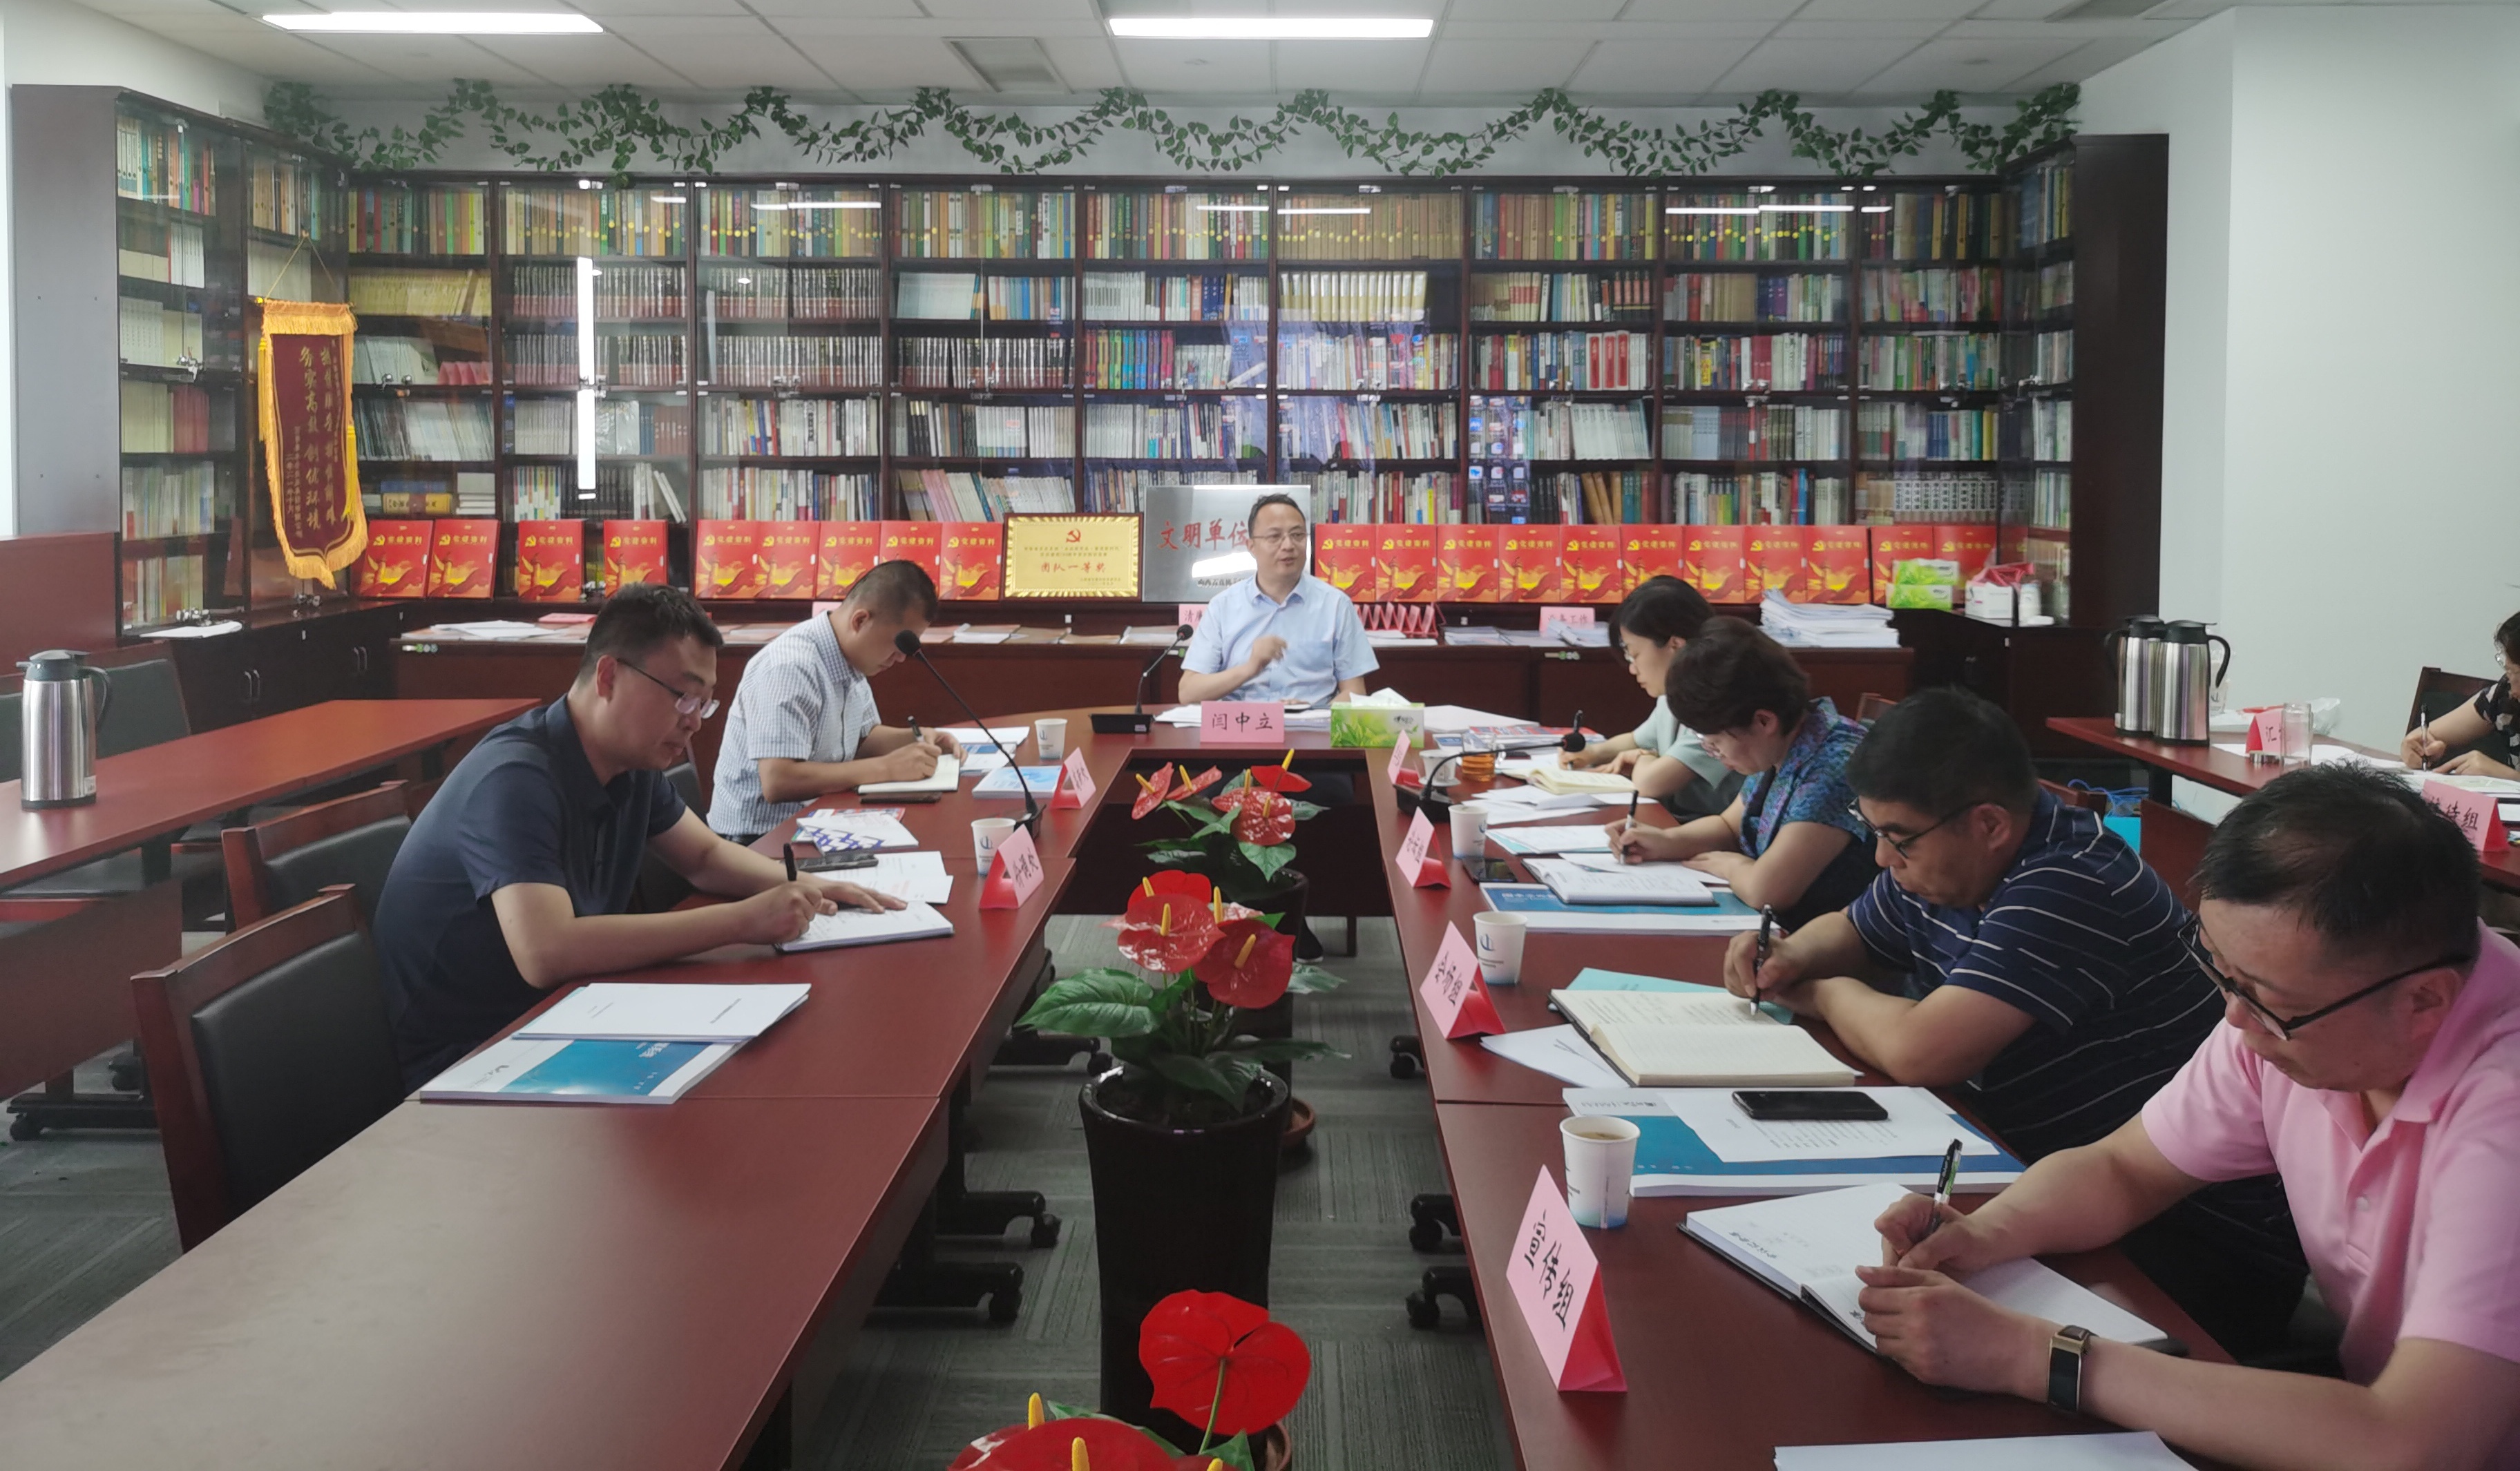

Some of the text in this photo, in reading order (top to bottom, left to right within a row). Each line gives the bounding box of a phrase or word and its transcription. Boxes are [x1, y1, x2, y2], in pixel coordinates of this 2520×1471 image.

[1157, 518, 1249, 550] 文明单位
[1212, 711, 1272, 732] 闫中立
[1524, 1209, 1574, 1331] 宣传组
